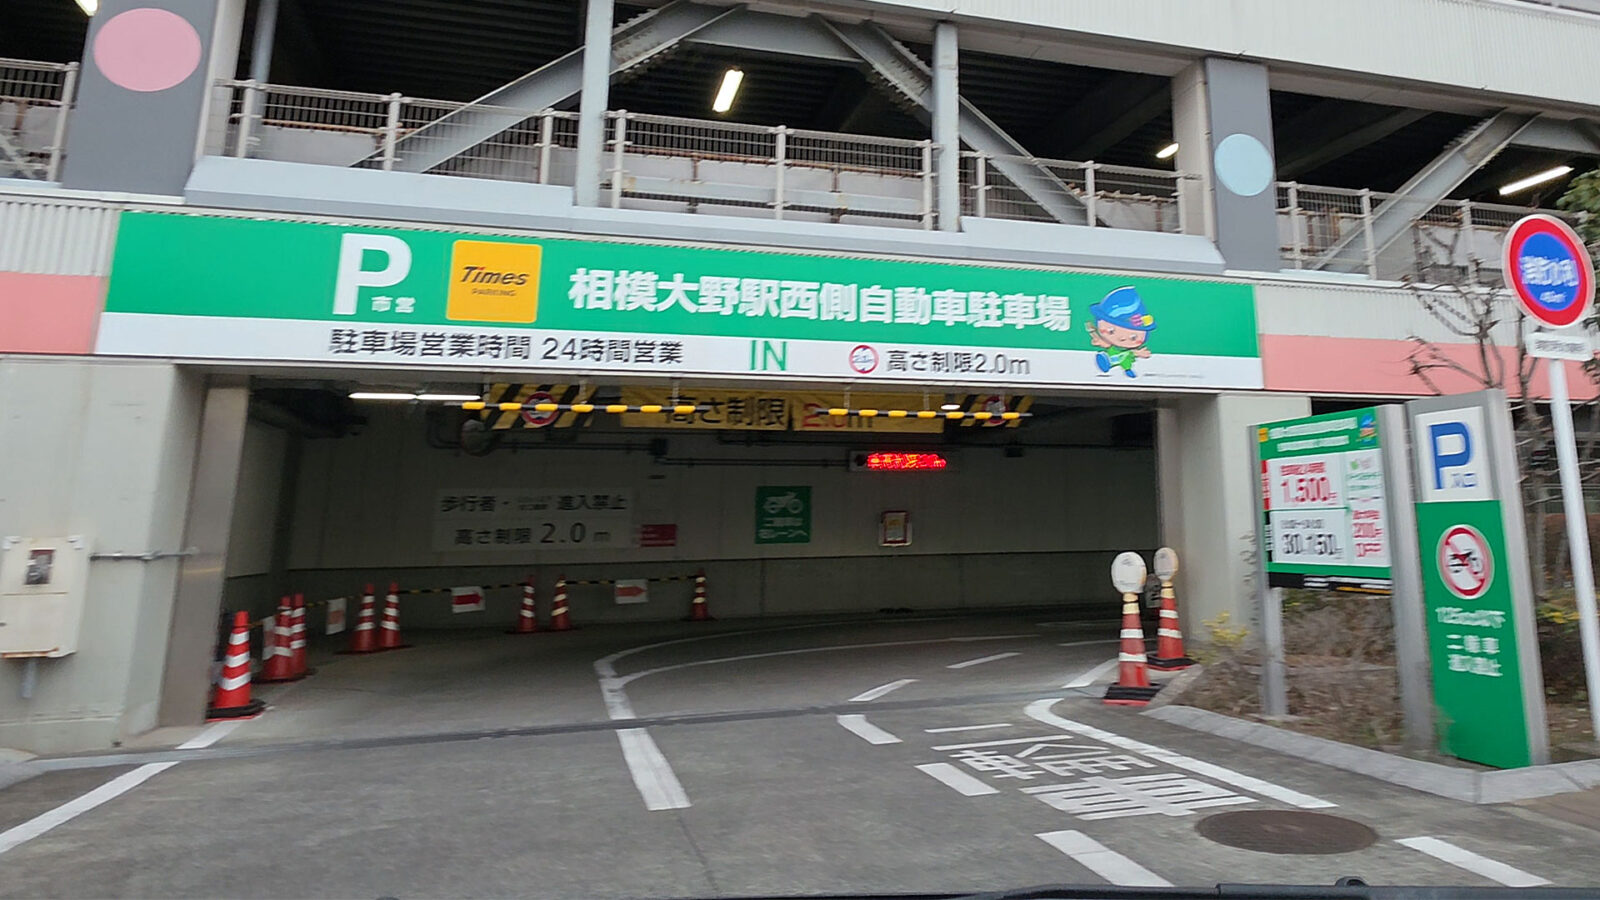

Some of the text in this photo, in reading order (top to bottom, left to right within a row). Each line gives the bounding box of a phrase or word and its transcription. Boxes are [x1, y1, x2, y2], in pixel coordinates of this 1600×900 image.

[334, 233, 412, 315] P
[461, 266, 530, 286] Times
[371, 295, 416, 313] 市営
[568, 267, 1071, 331] 相模大野駅西側自動車駐車場
[329, 329, 683, 364] 駐車場営業時間 24時間営業
[750, 340, 787, 371] IN
[887, 351, 1030, 374] 高さ制限2.0m
[667, 396, 787, 426] 高さ制限
[1429, 421, 1472, 491] P
